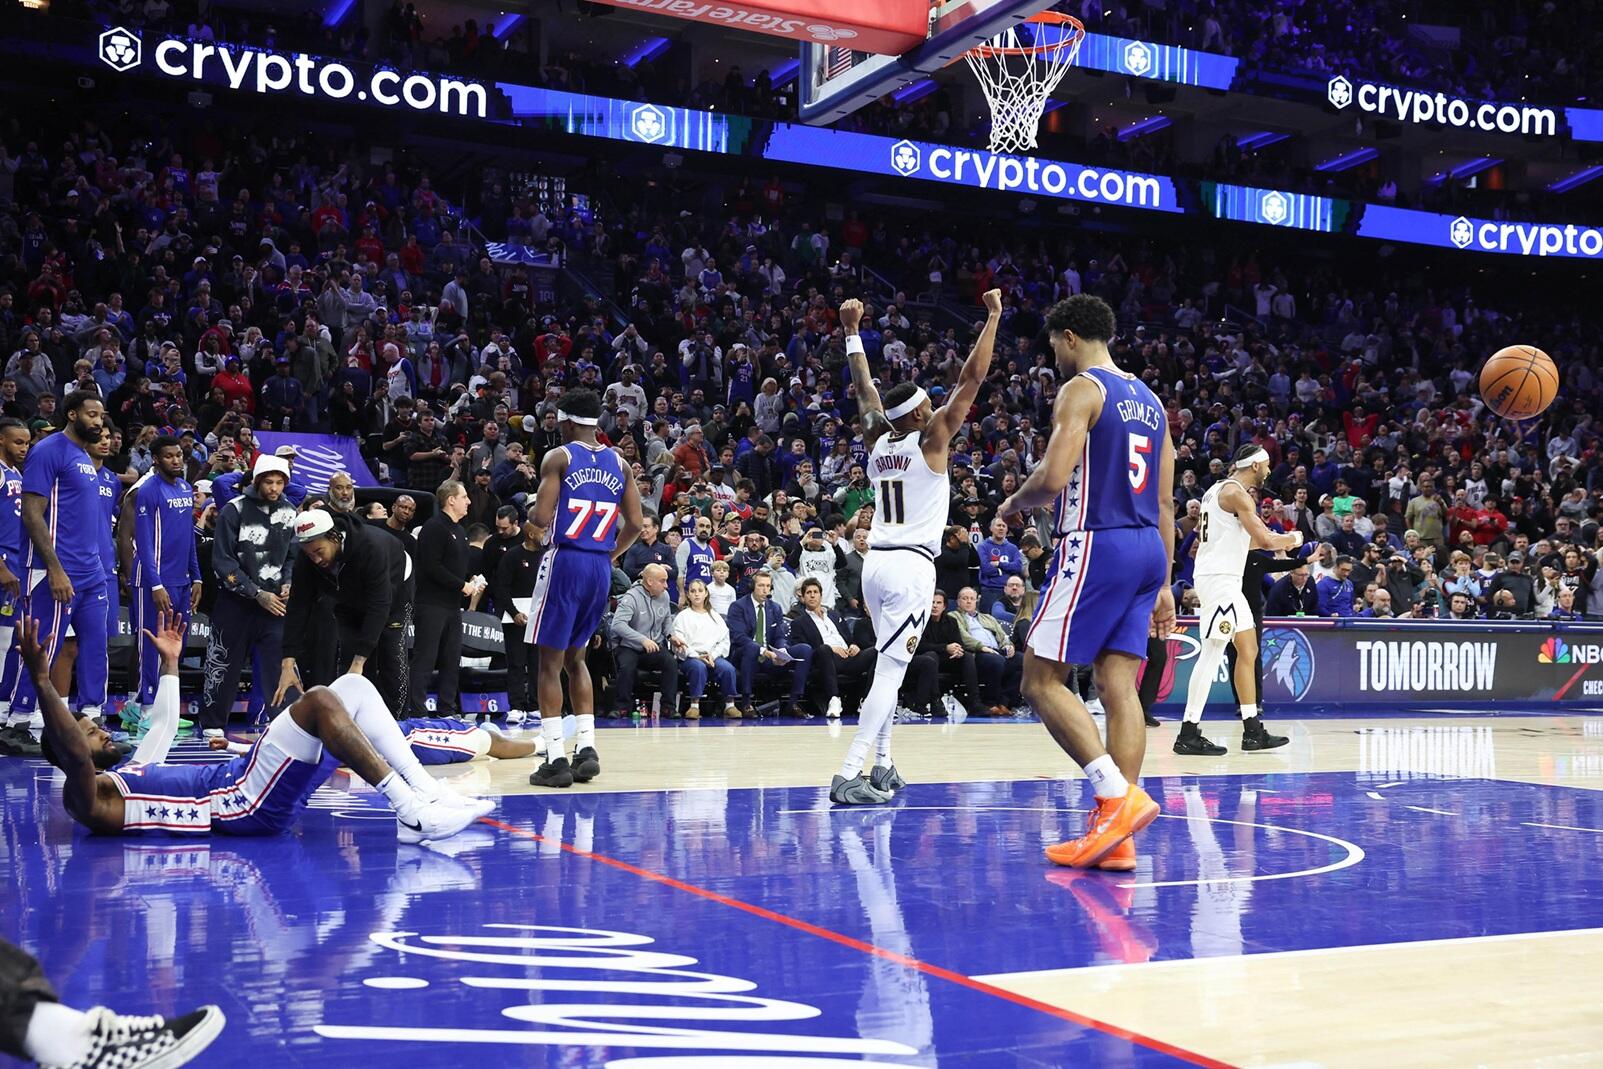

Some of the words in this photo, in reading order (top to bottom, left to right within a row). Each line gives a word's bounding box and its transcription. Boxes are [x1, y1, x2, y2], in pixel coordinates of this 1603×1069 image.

[155, 39, 487, 118] crypto.com
[1358, 84, 1557, 136] crypto.com
[928, 141, 1160, 207] crypto.com
[1116, 399, 1161, 432] GRIMES
[875, 454, 912, 473] BROWN
[1128, 432, 1152, 495] 5
[564, 467, 623, 496] EDGECOMBE
[166, 496, 193, 509] 76ERS
[880, 480, 905, 524] 11
[564, 497, 621, 542] 77
[972, 533, 979, 544] 0
[468, 624, 482, 638] THE
[489, 627, 505, 643] App
[1355, 640, 1498, 692] TOMORROW
[1572, 644, 1603, 665] NB
[479, 697, 499, 713] 76
